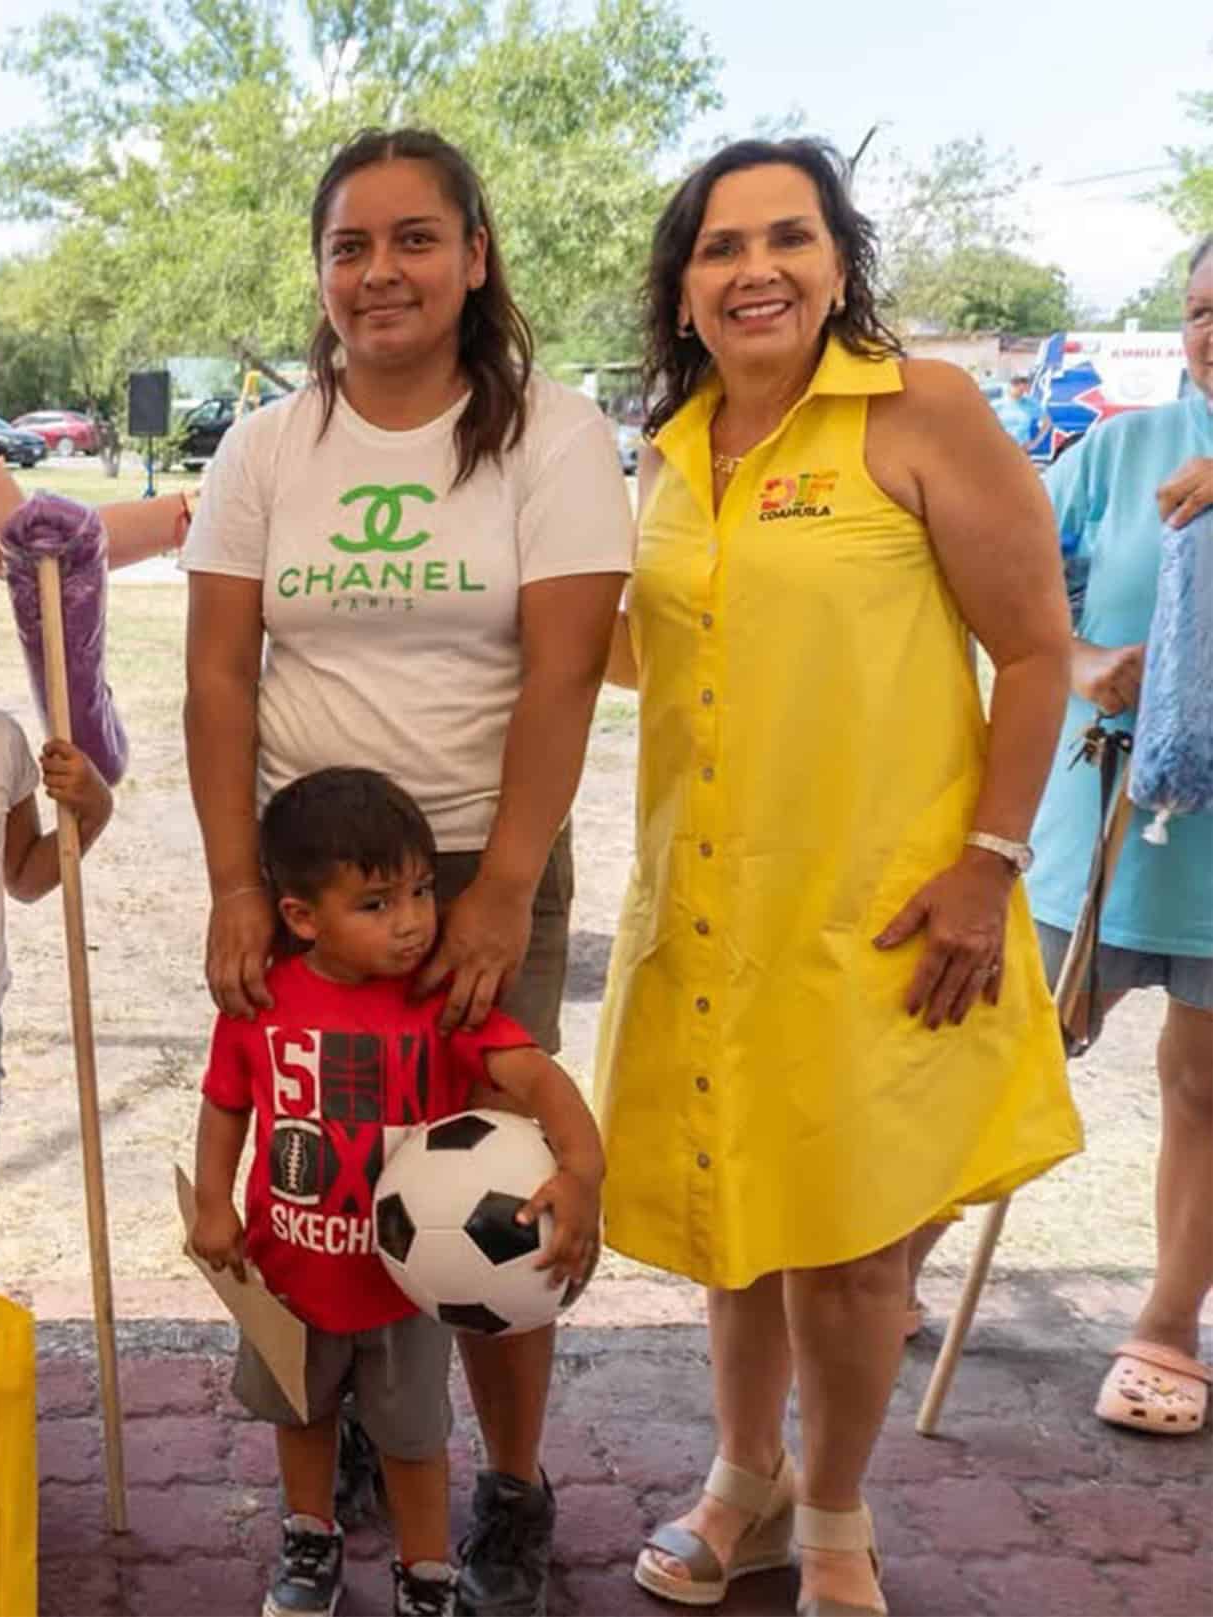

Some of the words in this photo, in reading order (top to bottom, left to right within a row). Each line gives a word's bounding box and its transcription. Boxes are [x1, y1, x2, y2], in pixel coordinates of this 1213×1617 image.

[761, 471, 837, 509] DIF
[277, 560, 486, 598] CHANEL
[270, 1203, 374, 1255] SKECH
